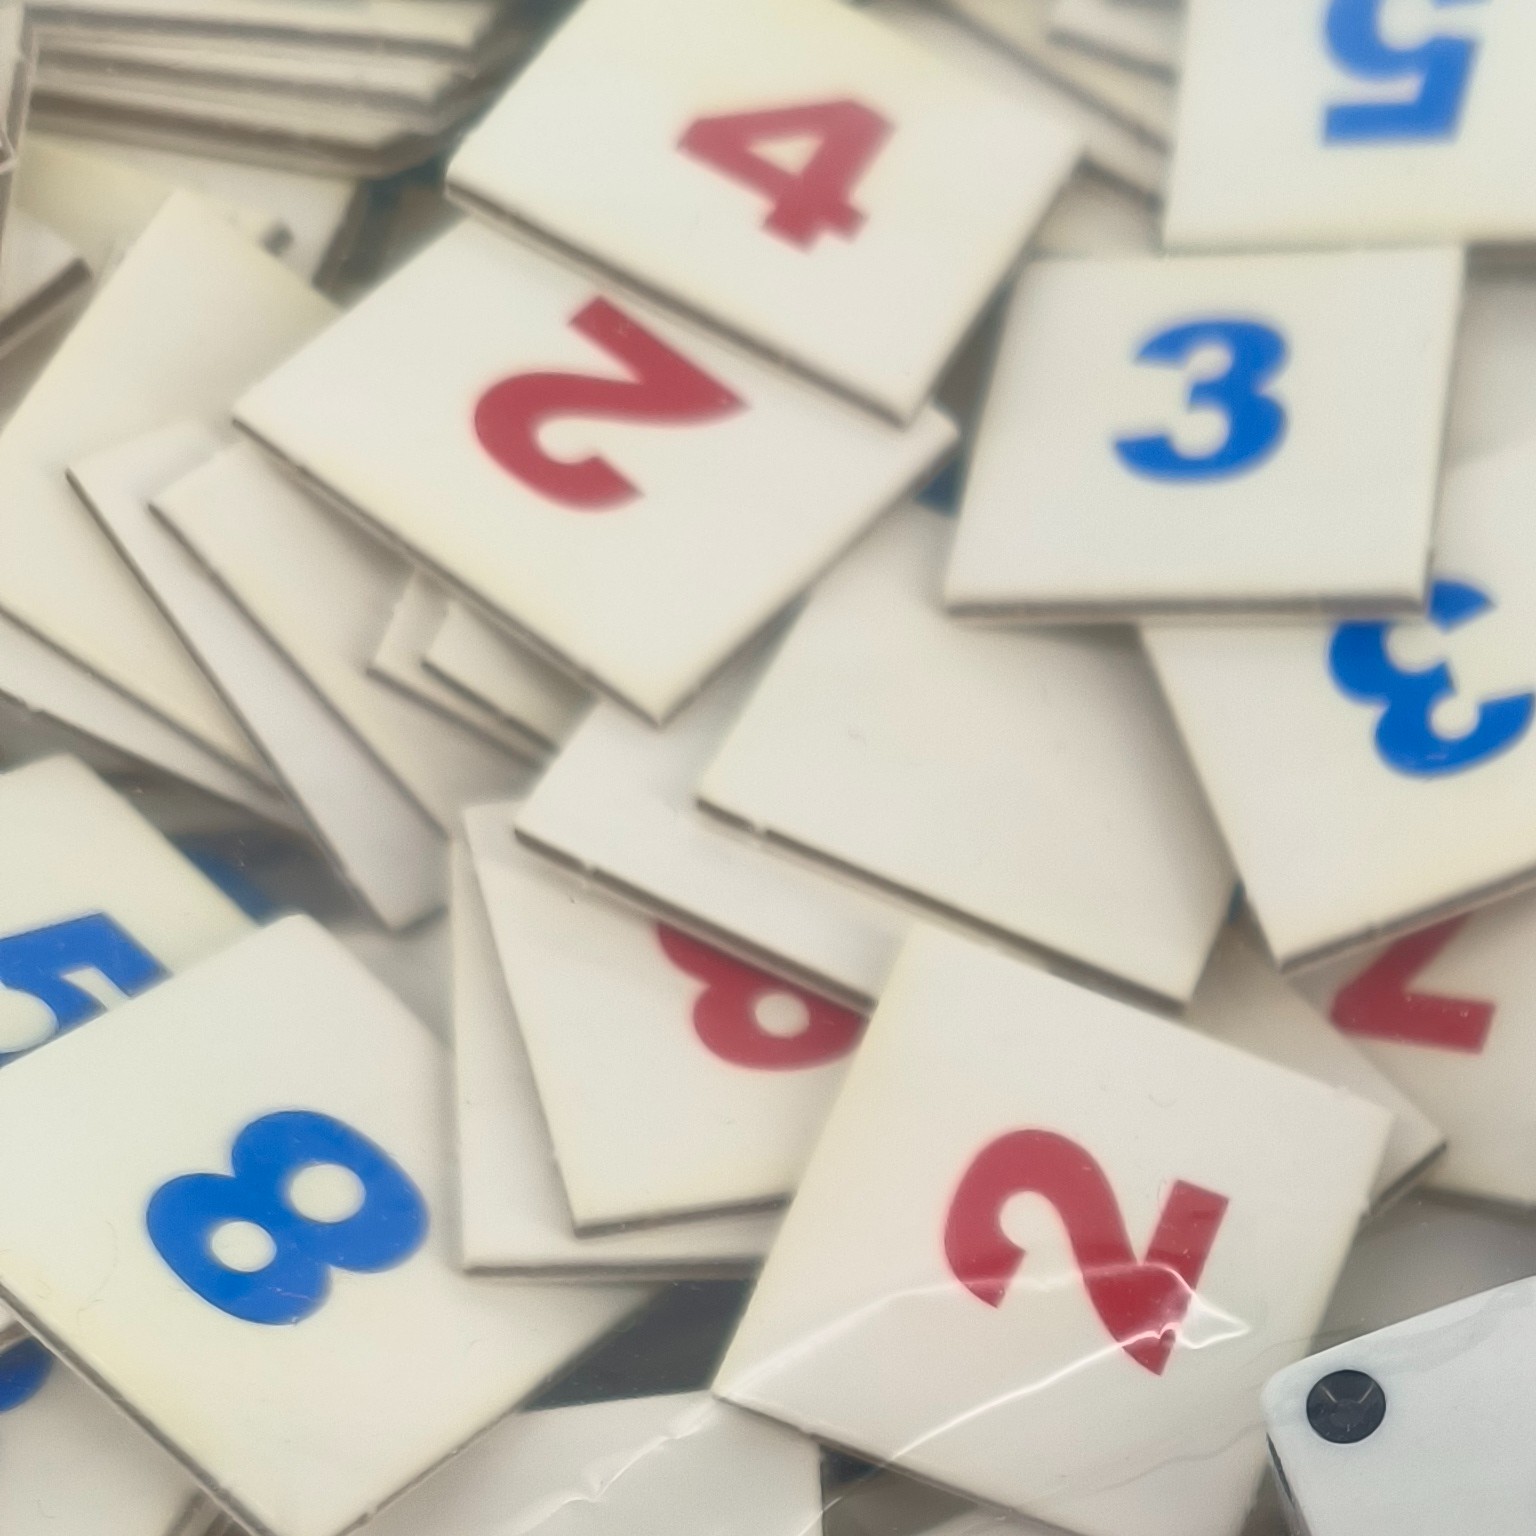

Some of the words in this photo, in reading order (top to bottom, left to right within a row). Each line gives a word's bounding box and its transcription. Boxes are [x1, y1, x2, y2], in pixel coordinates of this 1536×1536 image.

[1320, 0, 1487, 147] 5
[678, 97, 893, 252] 4
[473, 296, 750, 511] 2
[1113, 317, 1290, 483] 3
[1329, 579, 1536, 780] 3
[147, 1110, 429, 1325] 8
[944, 1128, 1230, 1376] 2
